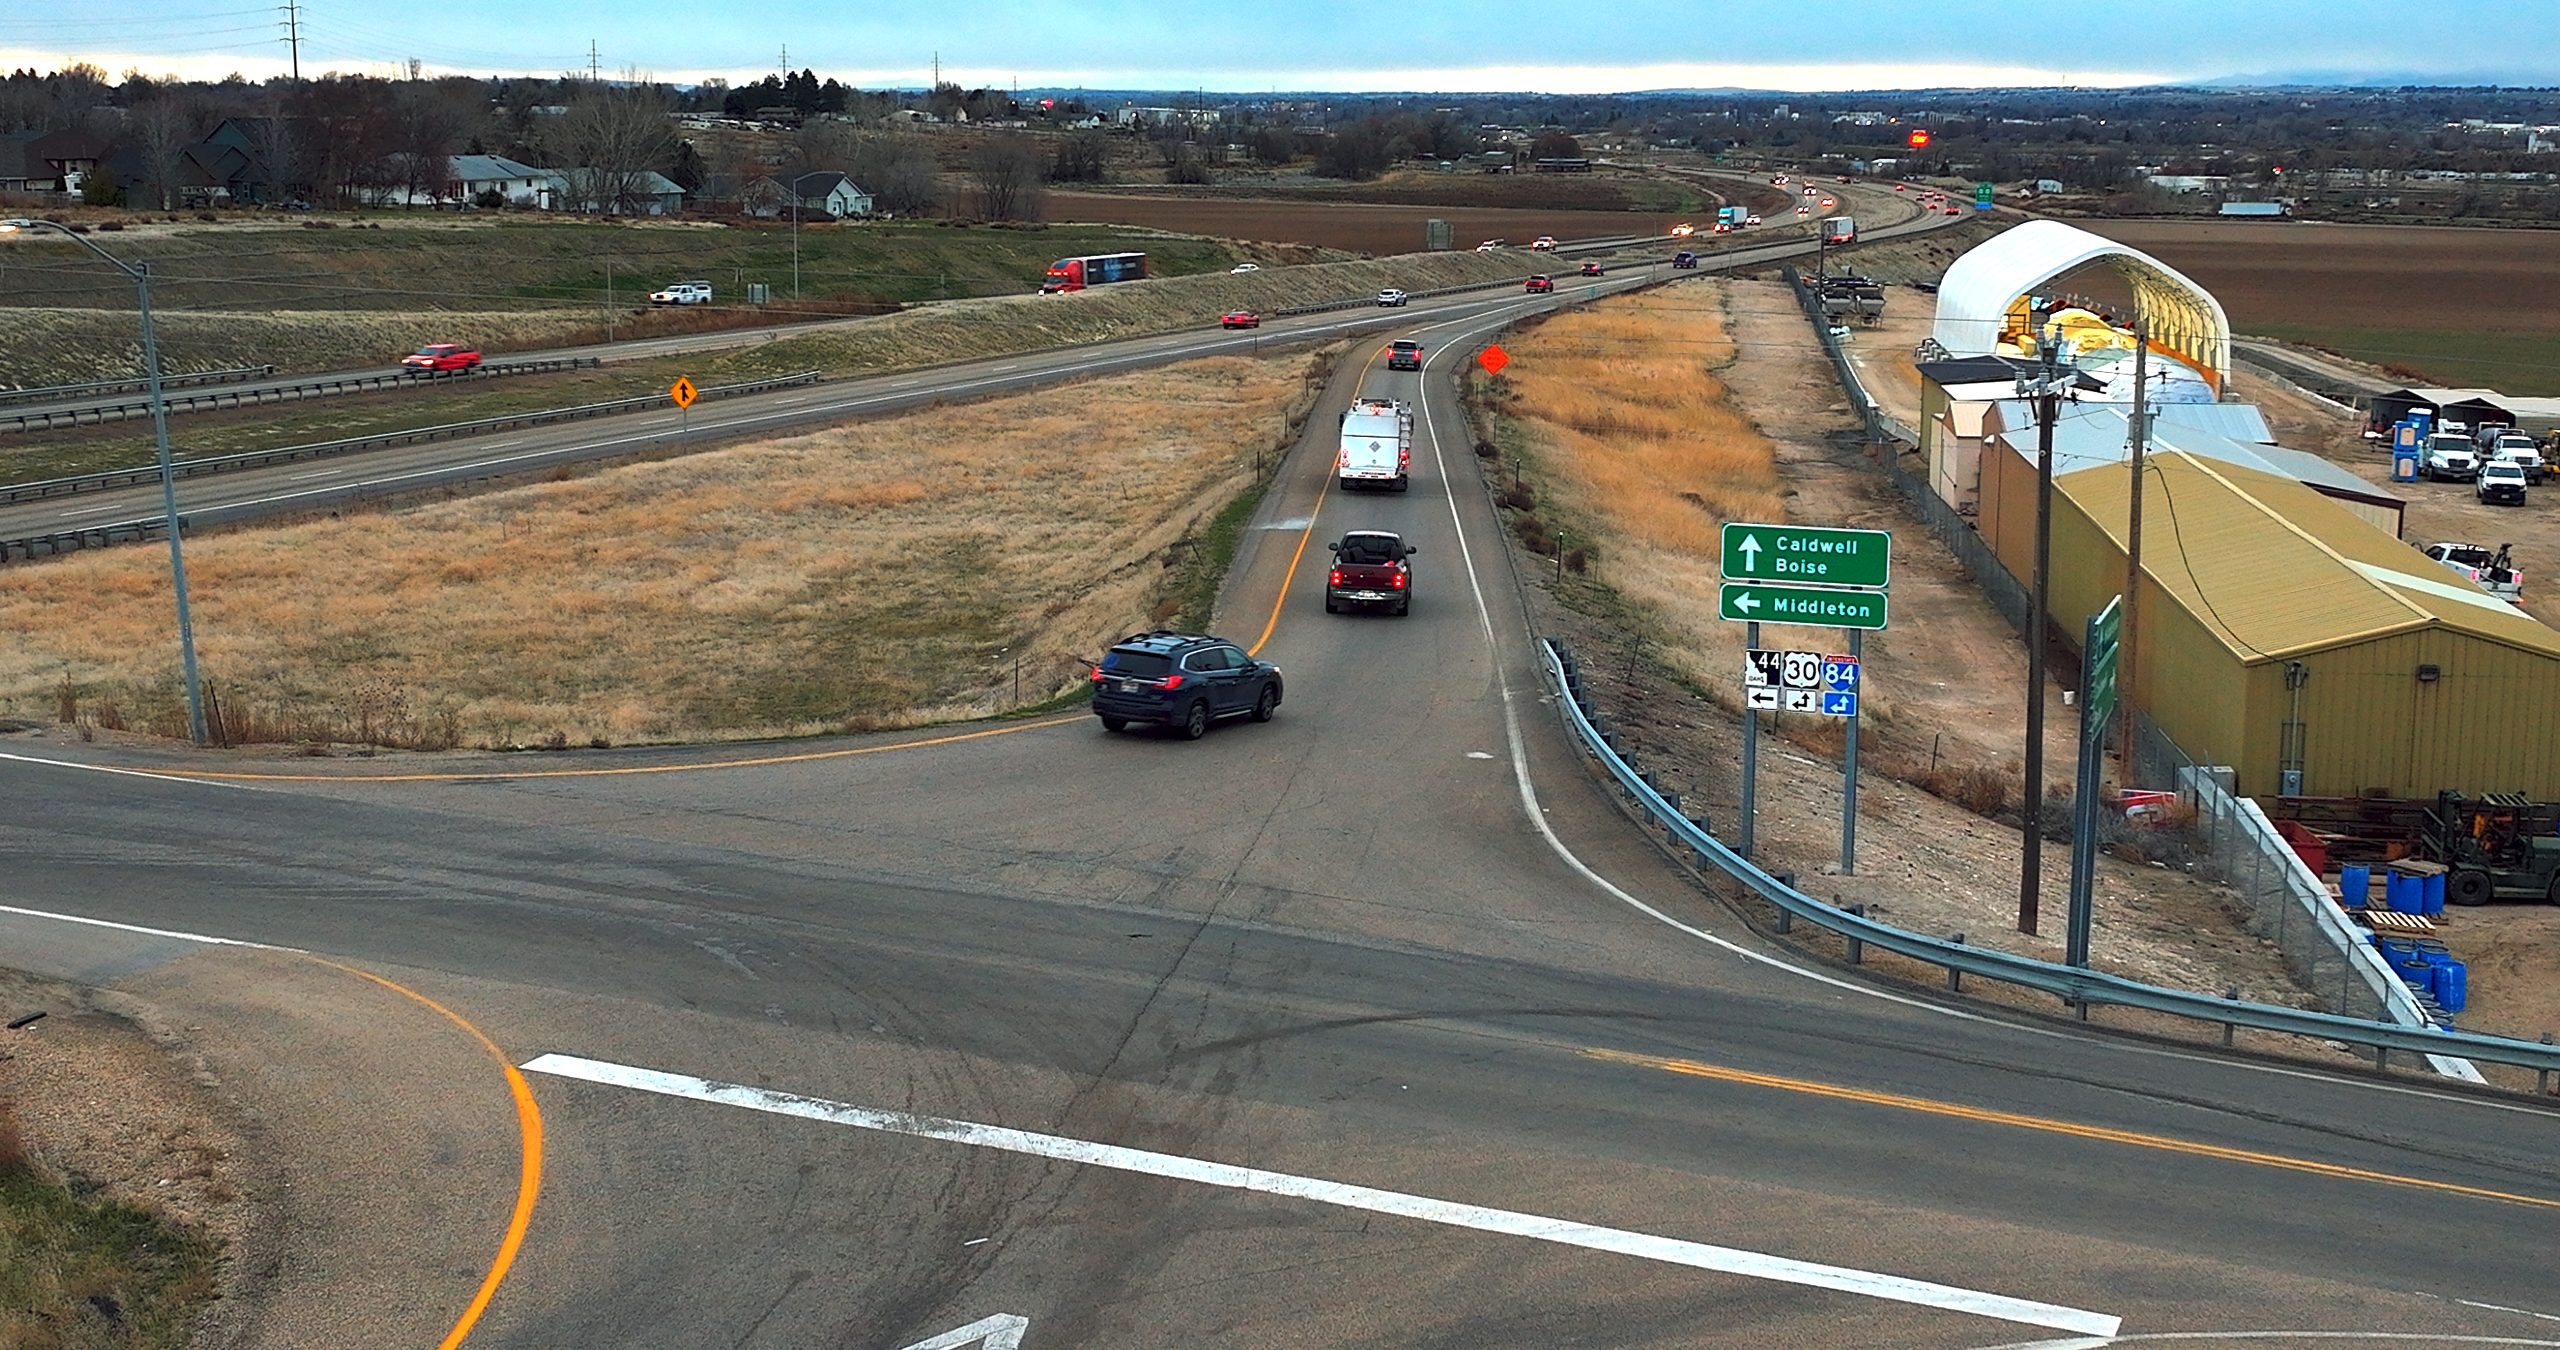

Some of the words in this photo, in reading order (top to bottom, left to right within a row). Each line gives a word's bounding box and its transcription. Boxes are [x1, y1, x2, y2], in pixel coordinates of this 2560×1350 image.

[1776, 536, 1857, 555] Caldwell
[1776, 558, 1828, 575] Boise
[1774, 598, 1870, 618] Middleton
[1758, 652, 1780, 670] 44
[1787, 660, 1817, 681] 30
[1825, 663, 1855, 685] 84
